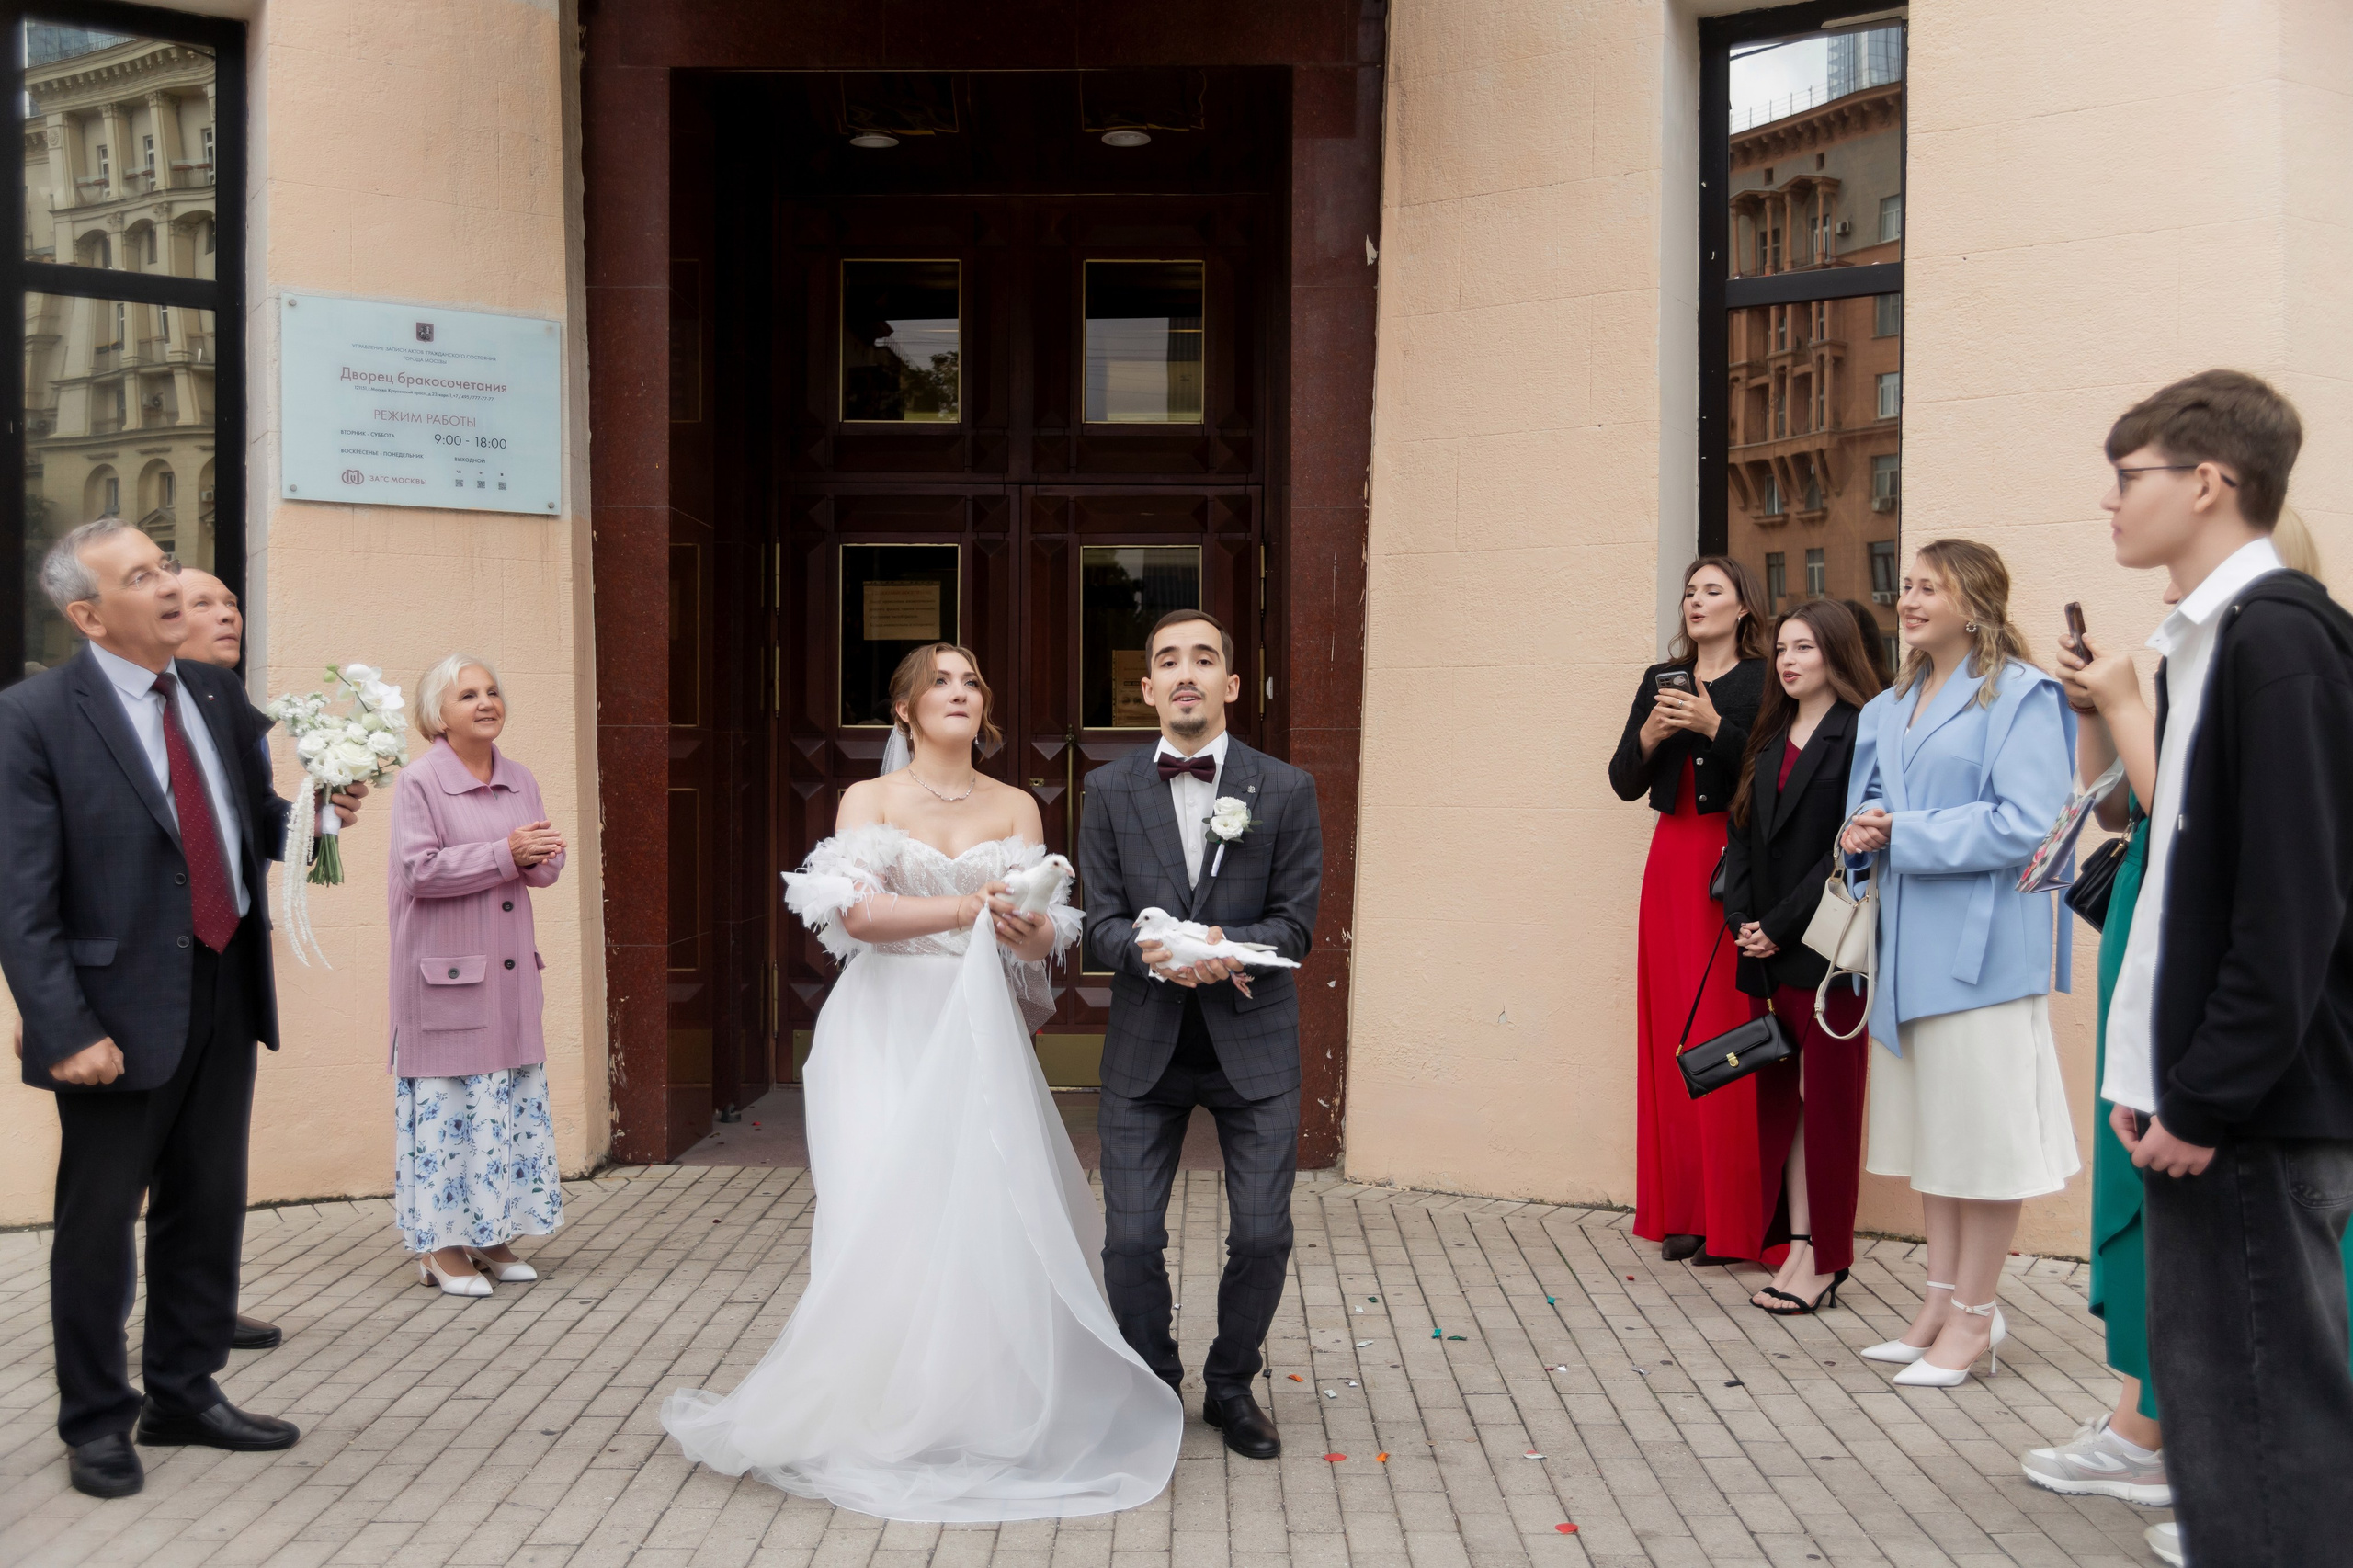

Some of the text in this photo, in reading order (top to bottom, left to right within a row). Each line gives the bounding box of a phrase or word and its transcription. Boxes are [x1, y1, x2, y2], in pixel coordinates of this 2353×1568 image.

[426, 350, 465, 358] ГРАЖДАНСКОГО
[340, 366, 507, 393] Дворец бракосочетания
[373, 409, 476, 427] РЕЖИМ РАБОТЫ
[434, 434, 462, 446] 9:00
[474, 437, 507, 449] 18:00
[383, 451, 424, 460] ПОНЕДЕЛЬНИК
[454, 456, 486, 464] ВЫХОДНОЙ
[369, 475, 427, 485] ЗАГС МОСКВЫ
